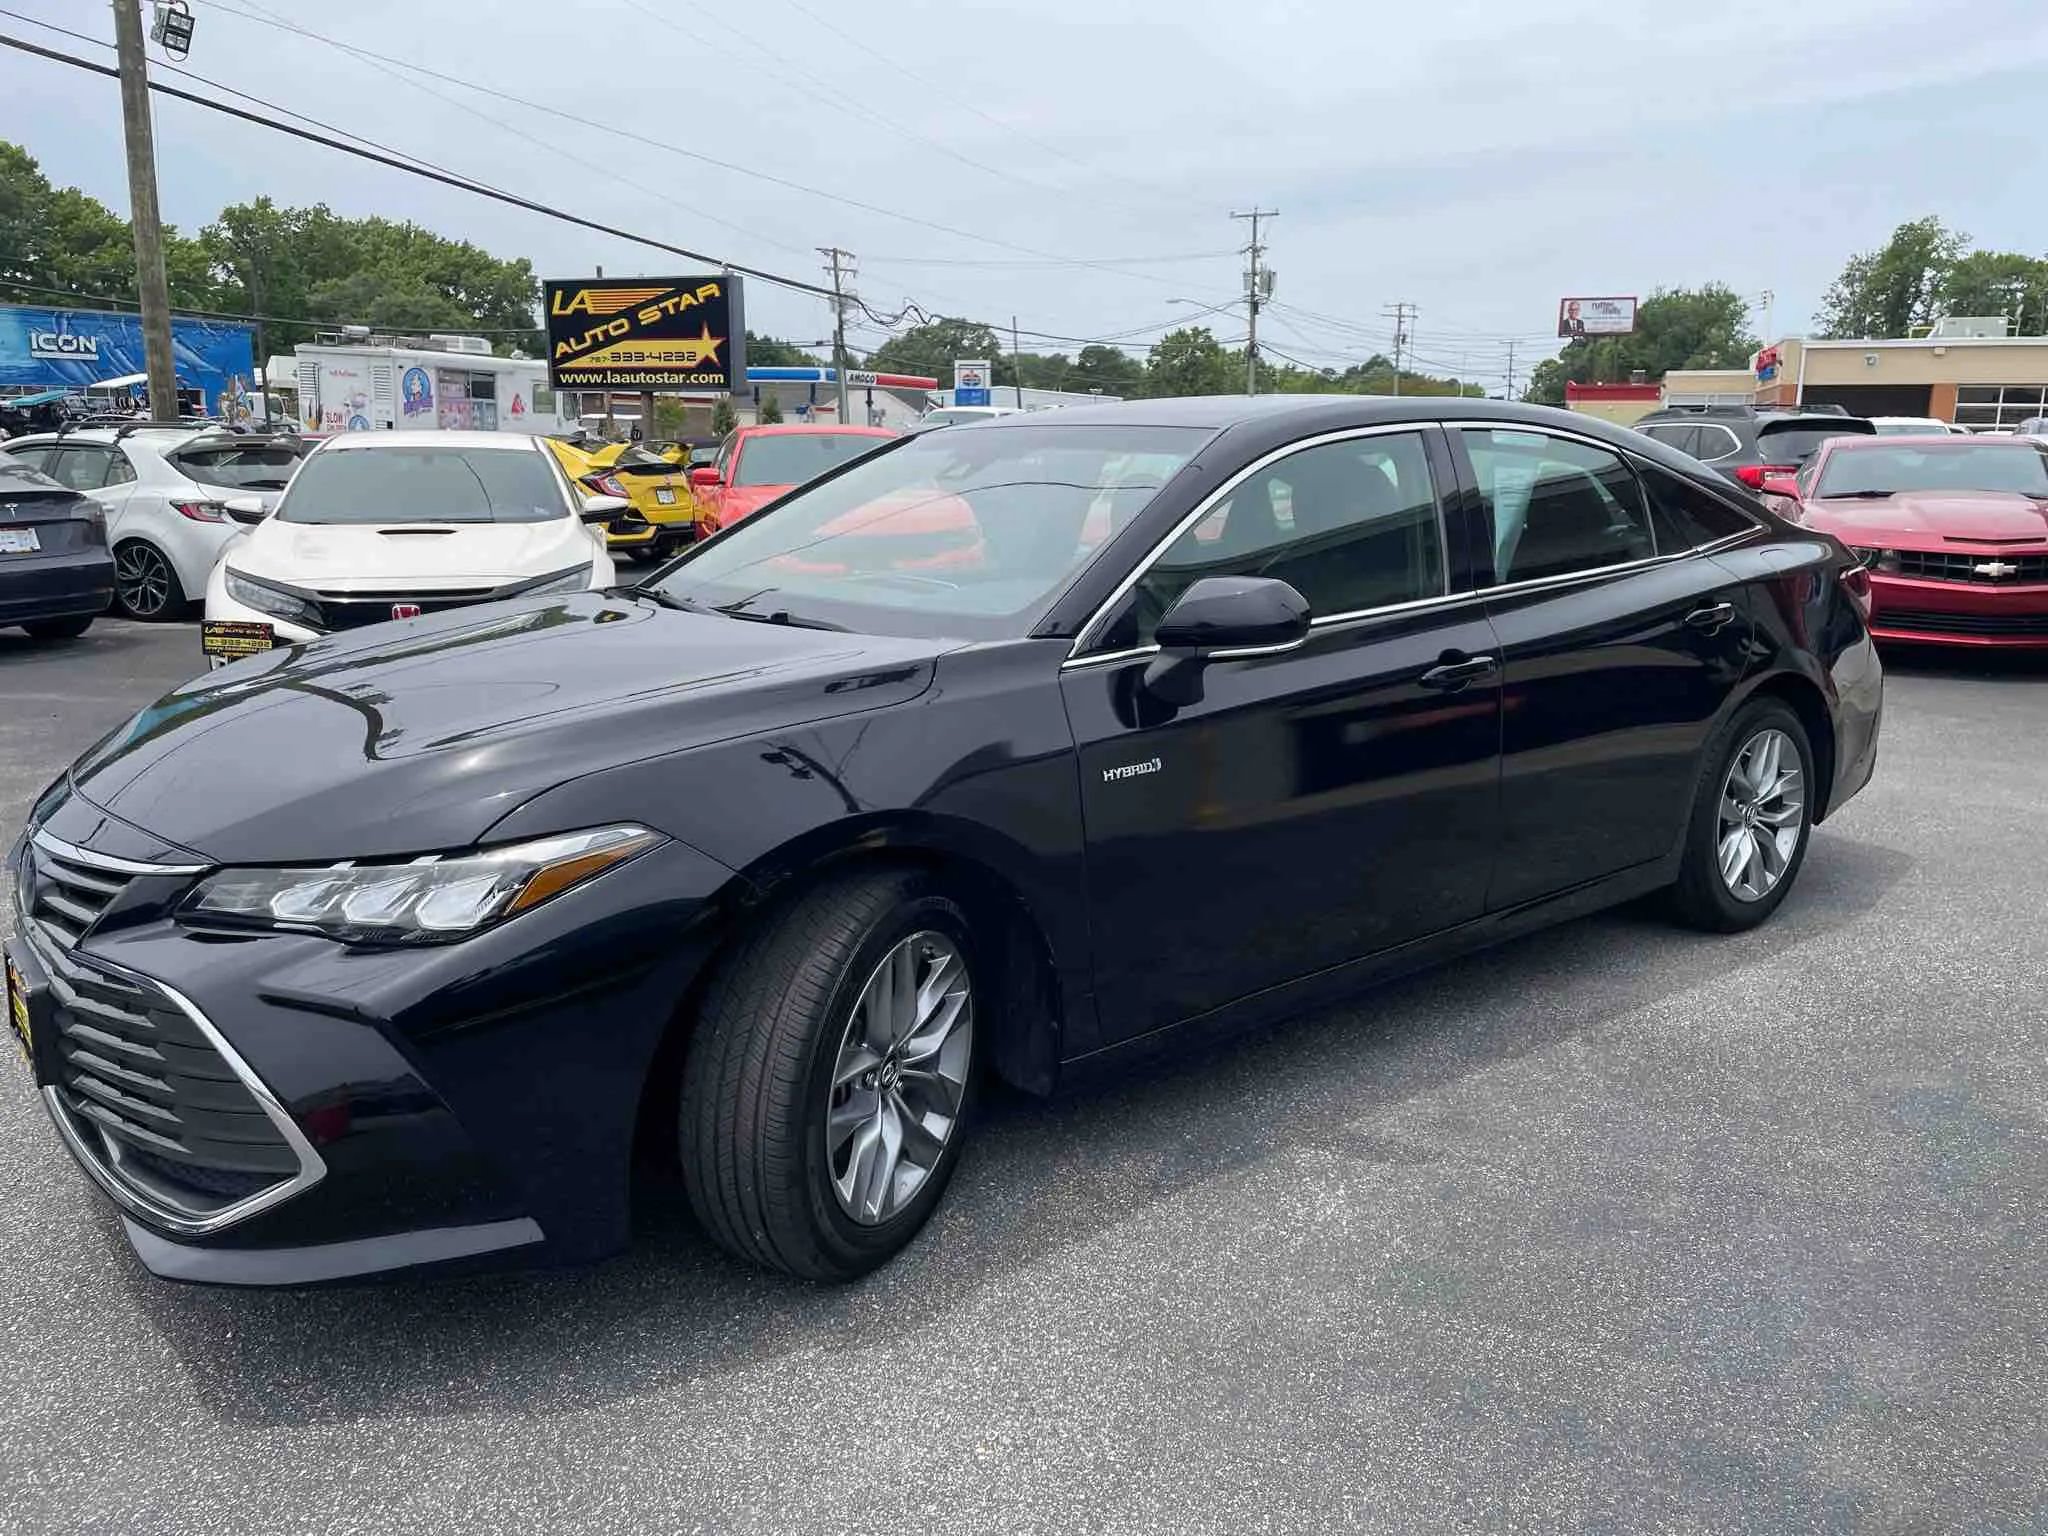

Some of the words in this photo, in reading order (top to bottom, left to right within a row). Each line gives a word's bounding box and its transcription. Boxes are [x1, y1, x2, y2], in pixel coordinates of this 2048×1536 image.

[551, 288, 592, 316] LA
[554, 317, 632, 359] AUTO
[637, 282, 722, 327] STAR
[31, 331, 97, 353] ICON
[559, 370, 725, 385] www.laautostar.com
[848, 373, 875, 383] AMOCO
[1103, 761, 1154, 781] HYBRID
